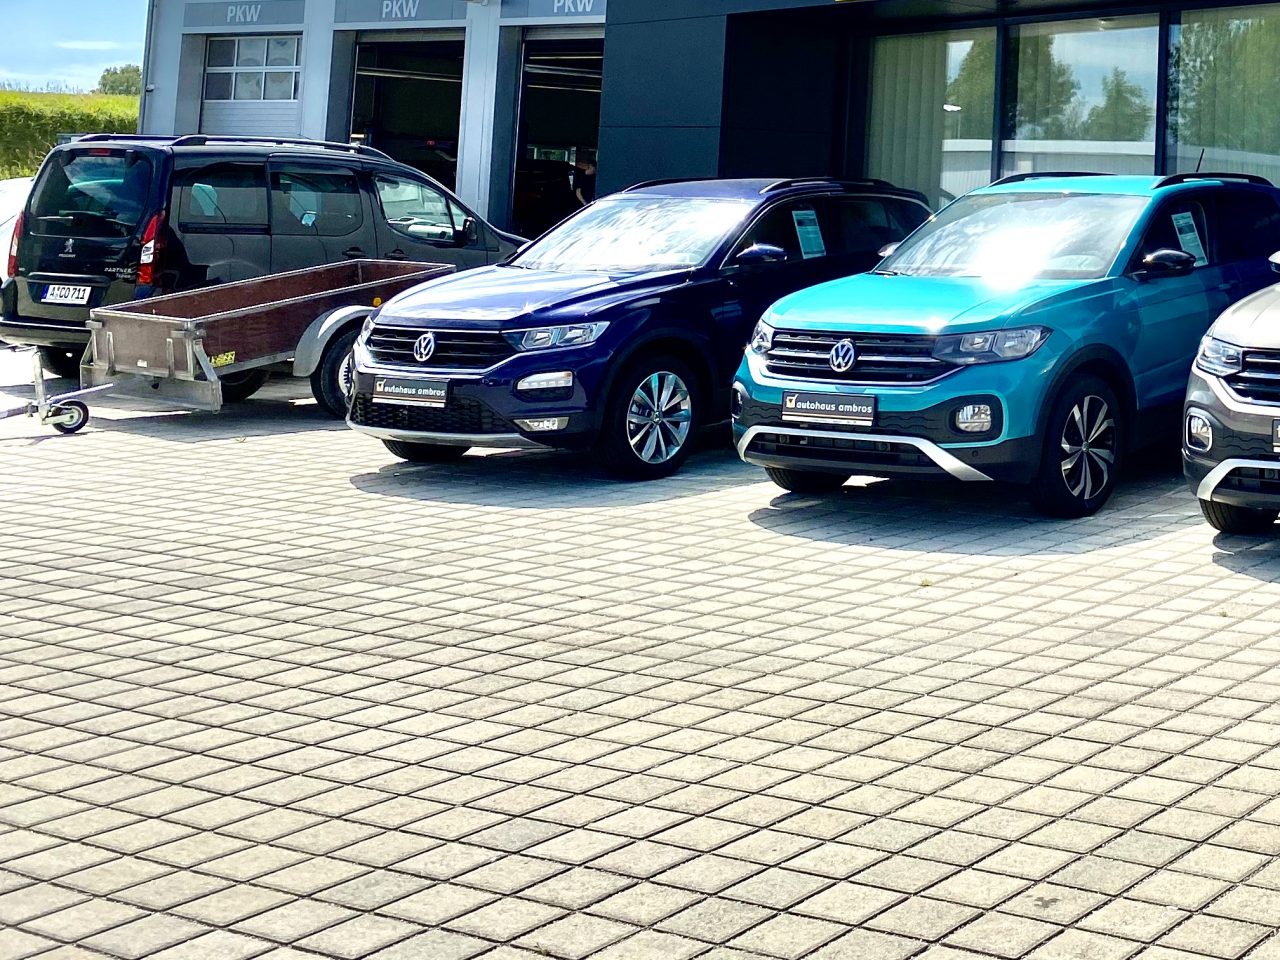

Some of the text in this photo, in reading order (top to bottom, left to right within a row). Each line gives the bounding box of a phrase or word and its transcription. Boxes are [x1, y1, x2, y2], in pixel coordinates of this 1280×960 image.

[227, 5, 261, 23] PKW
[382, 0, 419, 18] PKW
[384, 385, 445, 396] autohaus ambros
[796, 401, 872, 413] autohaus ambros
